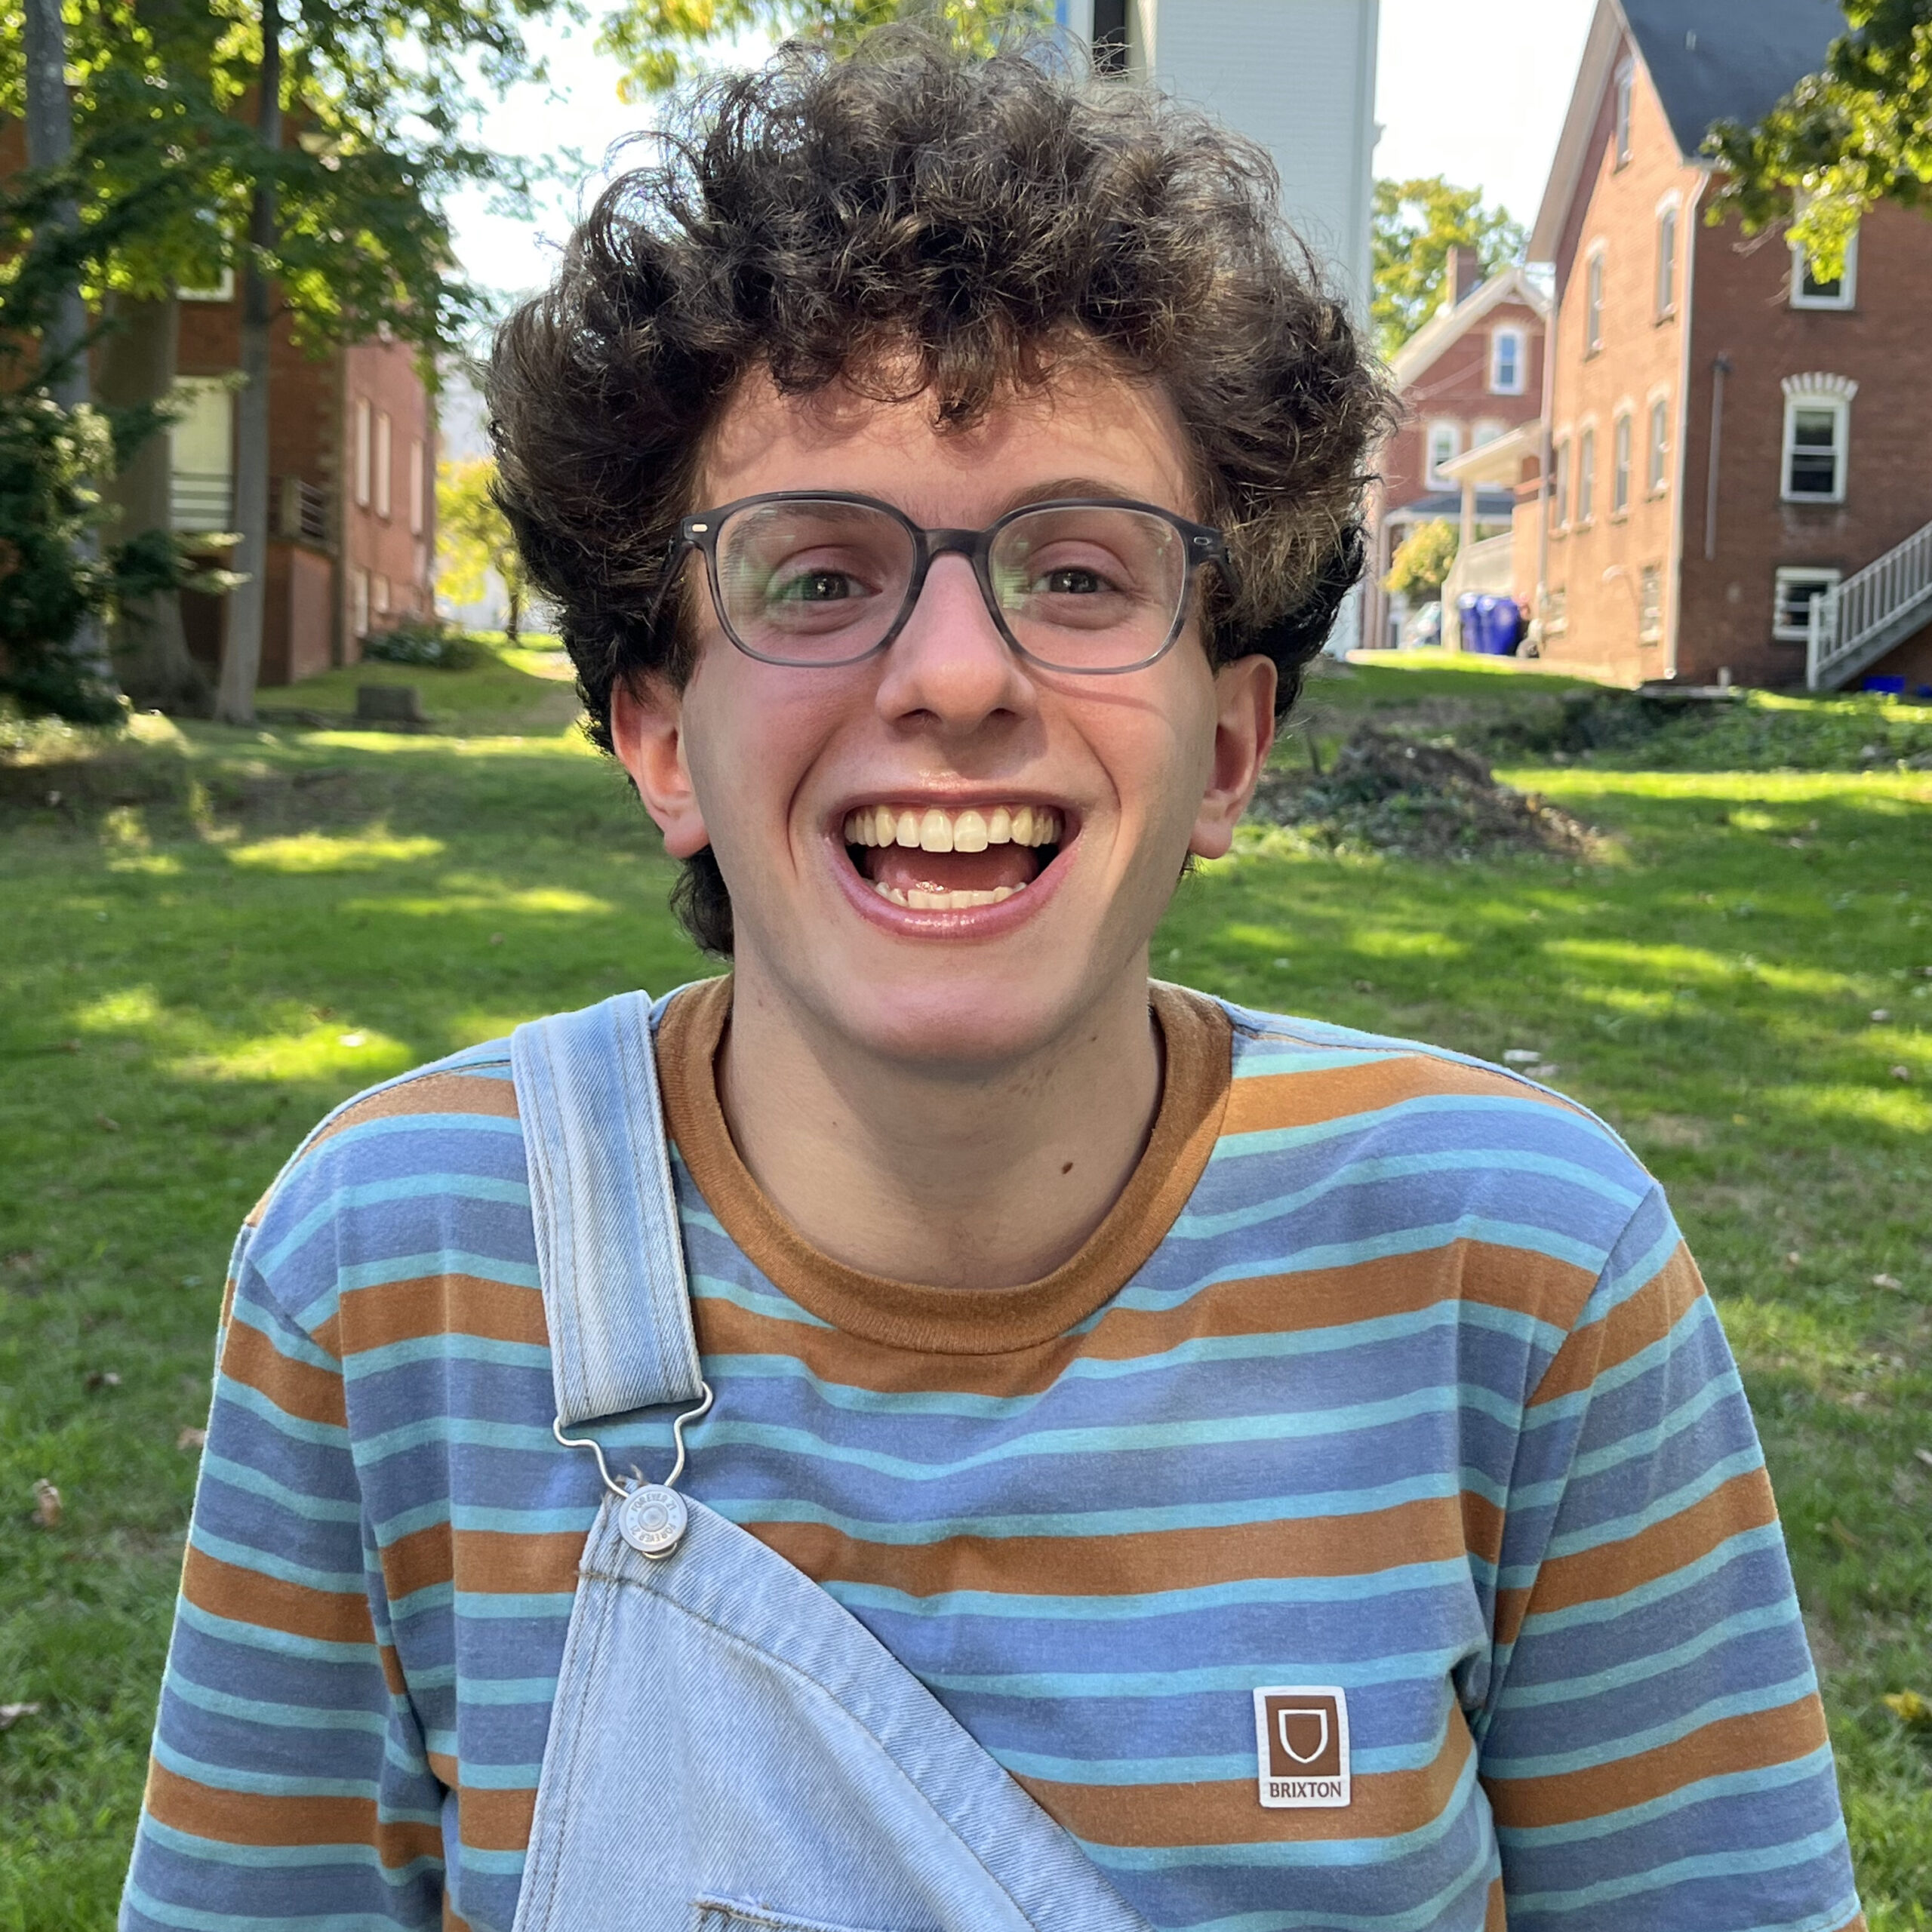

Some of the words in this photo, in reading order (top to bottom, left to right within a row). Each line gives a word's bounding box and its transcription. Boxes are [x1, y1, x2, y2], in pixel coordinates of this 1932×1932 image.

[631, 1493, 668, 1512] FOREVER
[666, 1500, 677, 1510] 21
[629, 1524, 640, 1535] 21
[638, 1523, 676, 1543] FOREVER
[1269, 1782, 1341, 1798] BRIXTON
